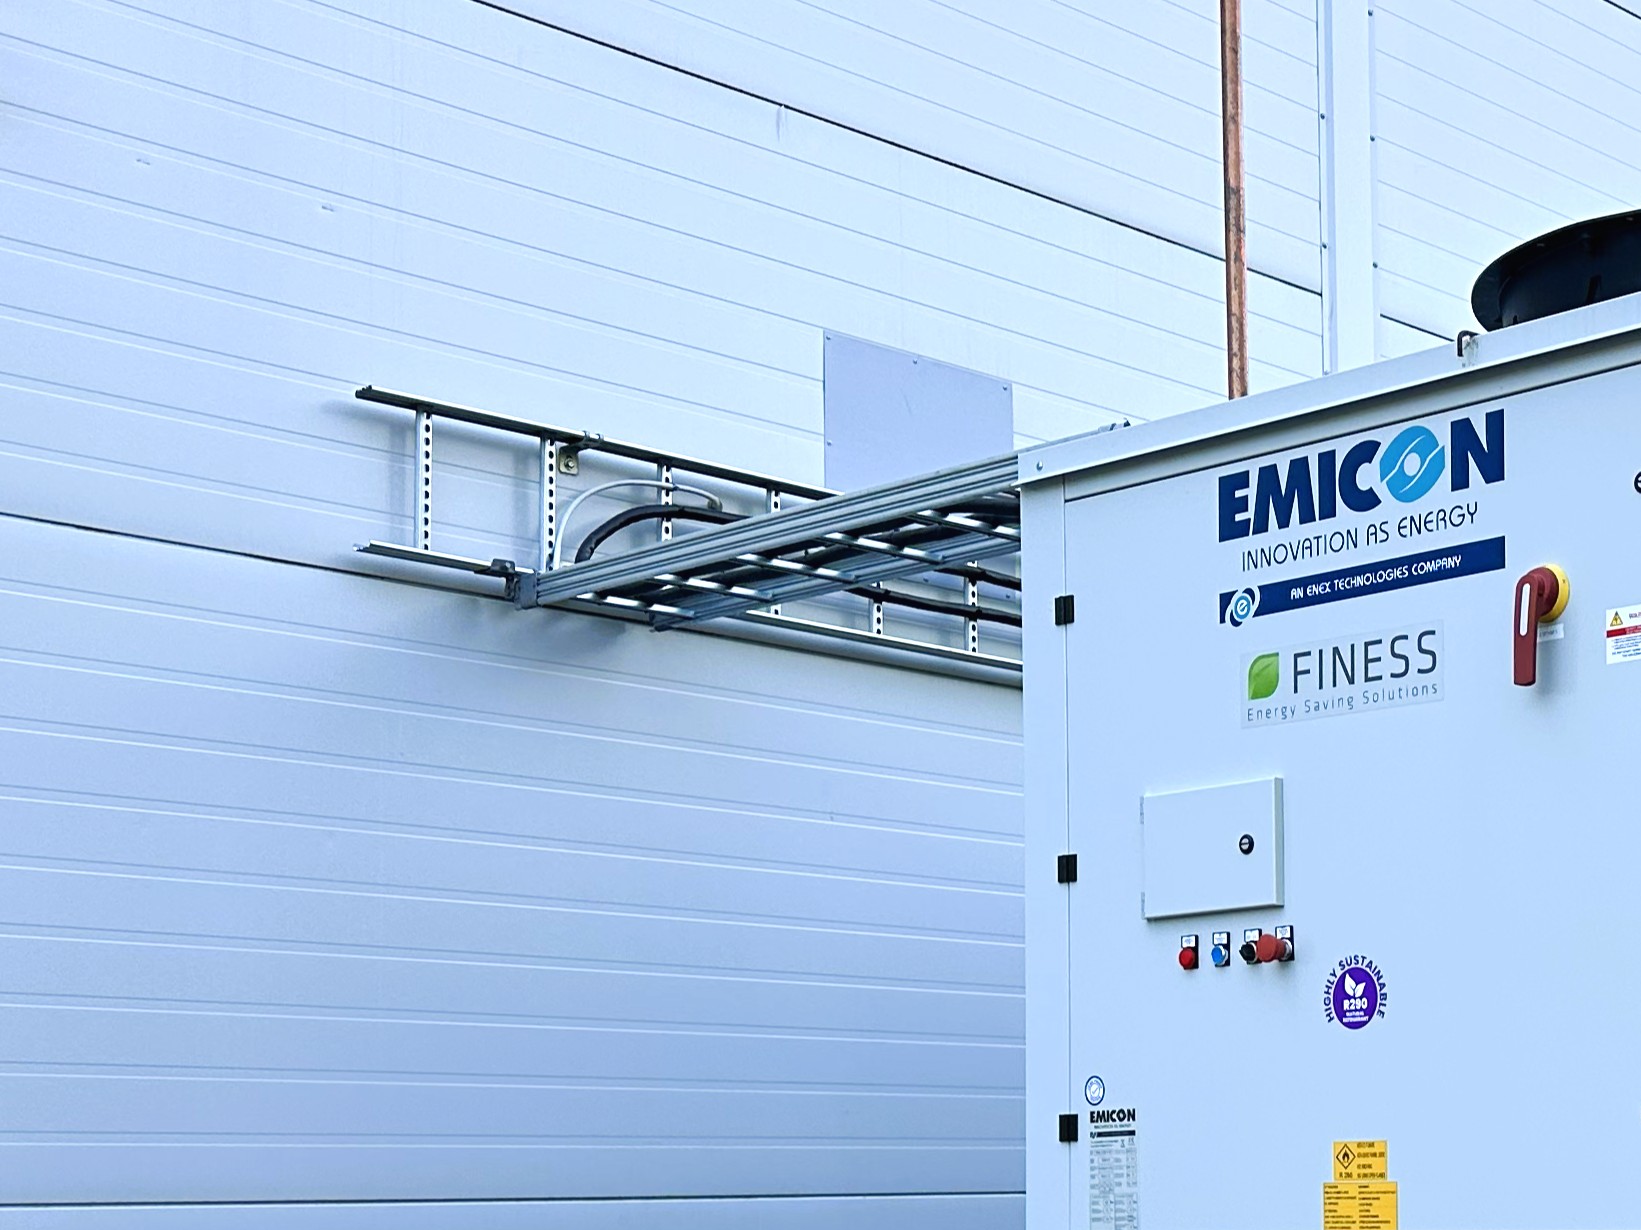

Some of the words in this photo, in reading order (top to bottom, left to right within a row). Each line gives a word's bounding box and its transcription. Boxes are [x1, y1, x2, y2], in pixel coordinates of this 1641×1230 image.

[1218, 408, 1505, 541] EMICON
[1242, 527, 1358, 572] INNOVATION
[1366, 520, 1390, 546] AS
[1397, 501, 1478, 538] ENERGY
[1290, 586, 1304, 600] AN
[1306, 580, 1332, 597] ENEX
[1333, 564, 1409, 592] TECHNOLOGIES
[1411, 553, 1462, 576] COMPANY
[1293, 629, 1437, 694] FINESS
[1247, 704, 1297, 721] Energy
[1304, 695, 1354, 713] Saving
[1362, 683, 1438, 704] Solutions
[1323, 967, 1338, 1024] HIGHLY
[1338, 954, 1388, 1019] SUSTAINABLE
[1343, 997, 1368, 1011] R290
[1089, 1108, 1136, 1124] EMICON
